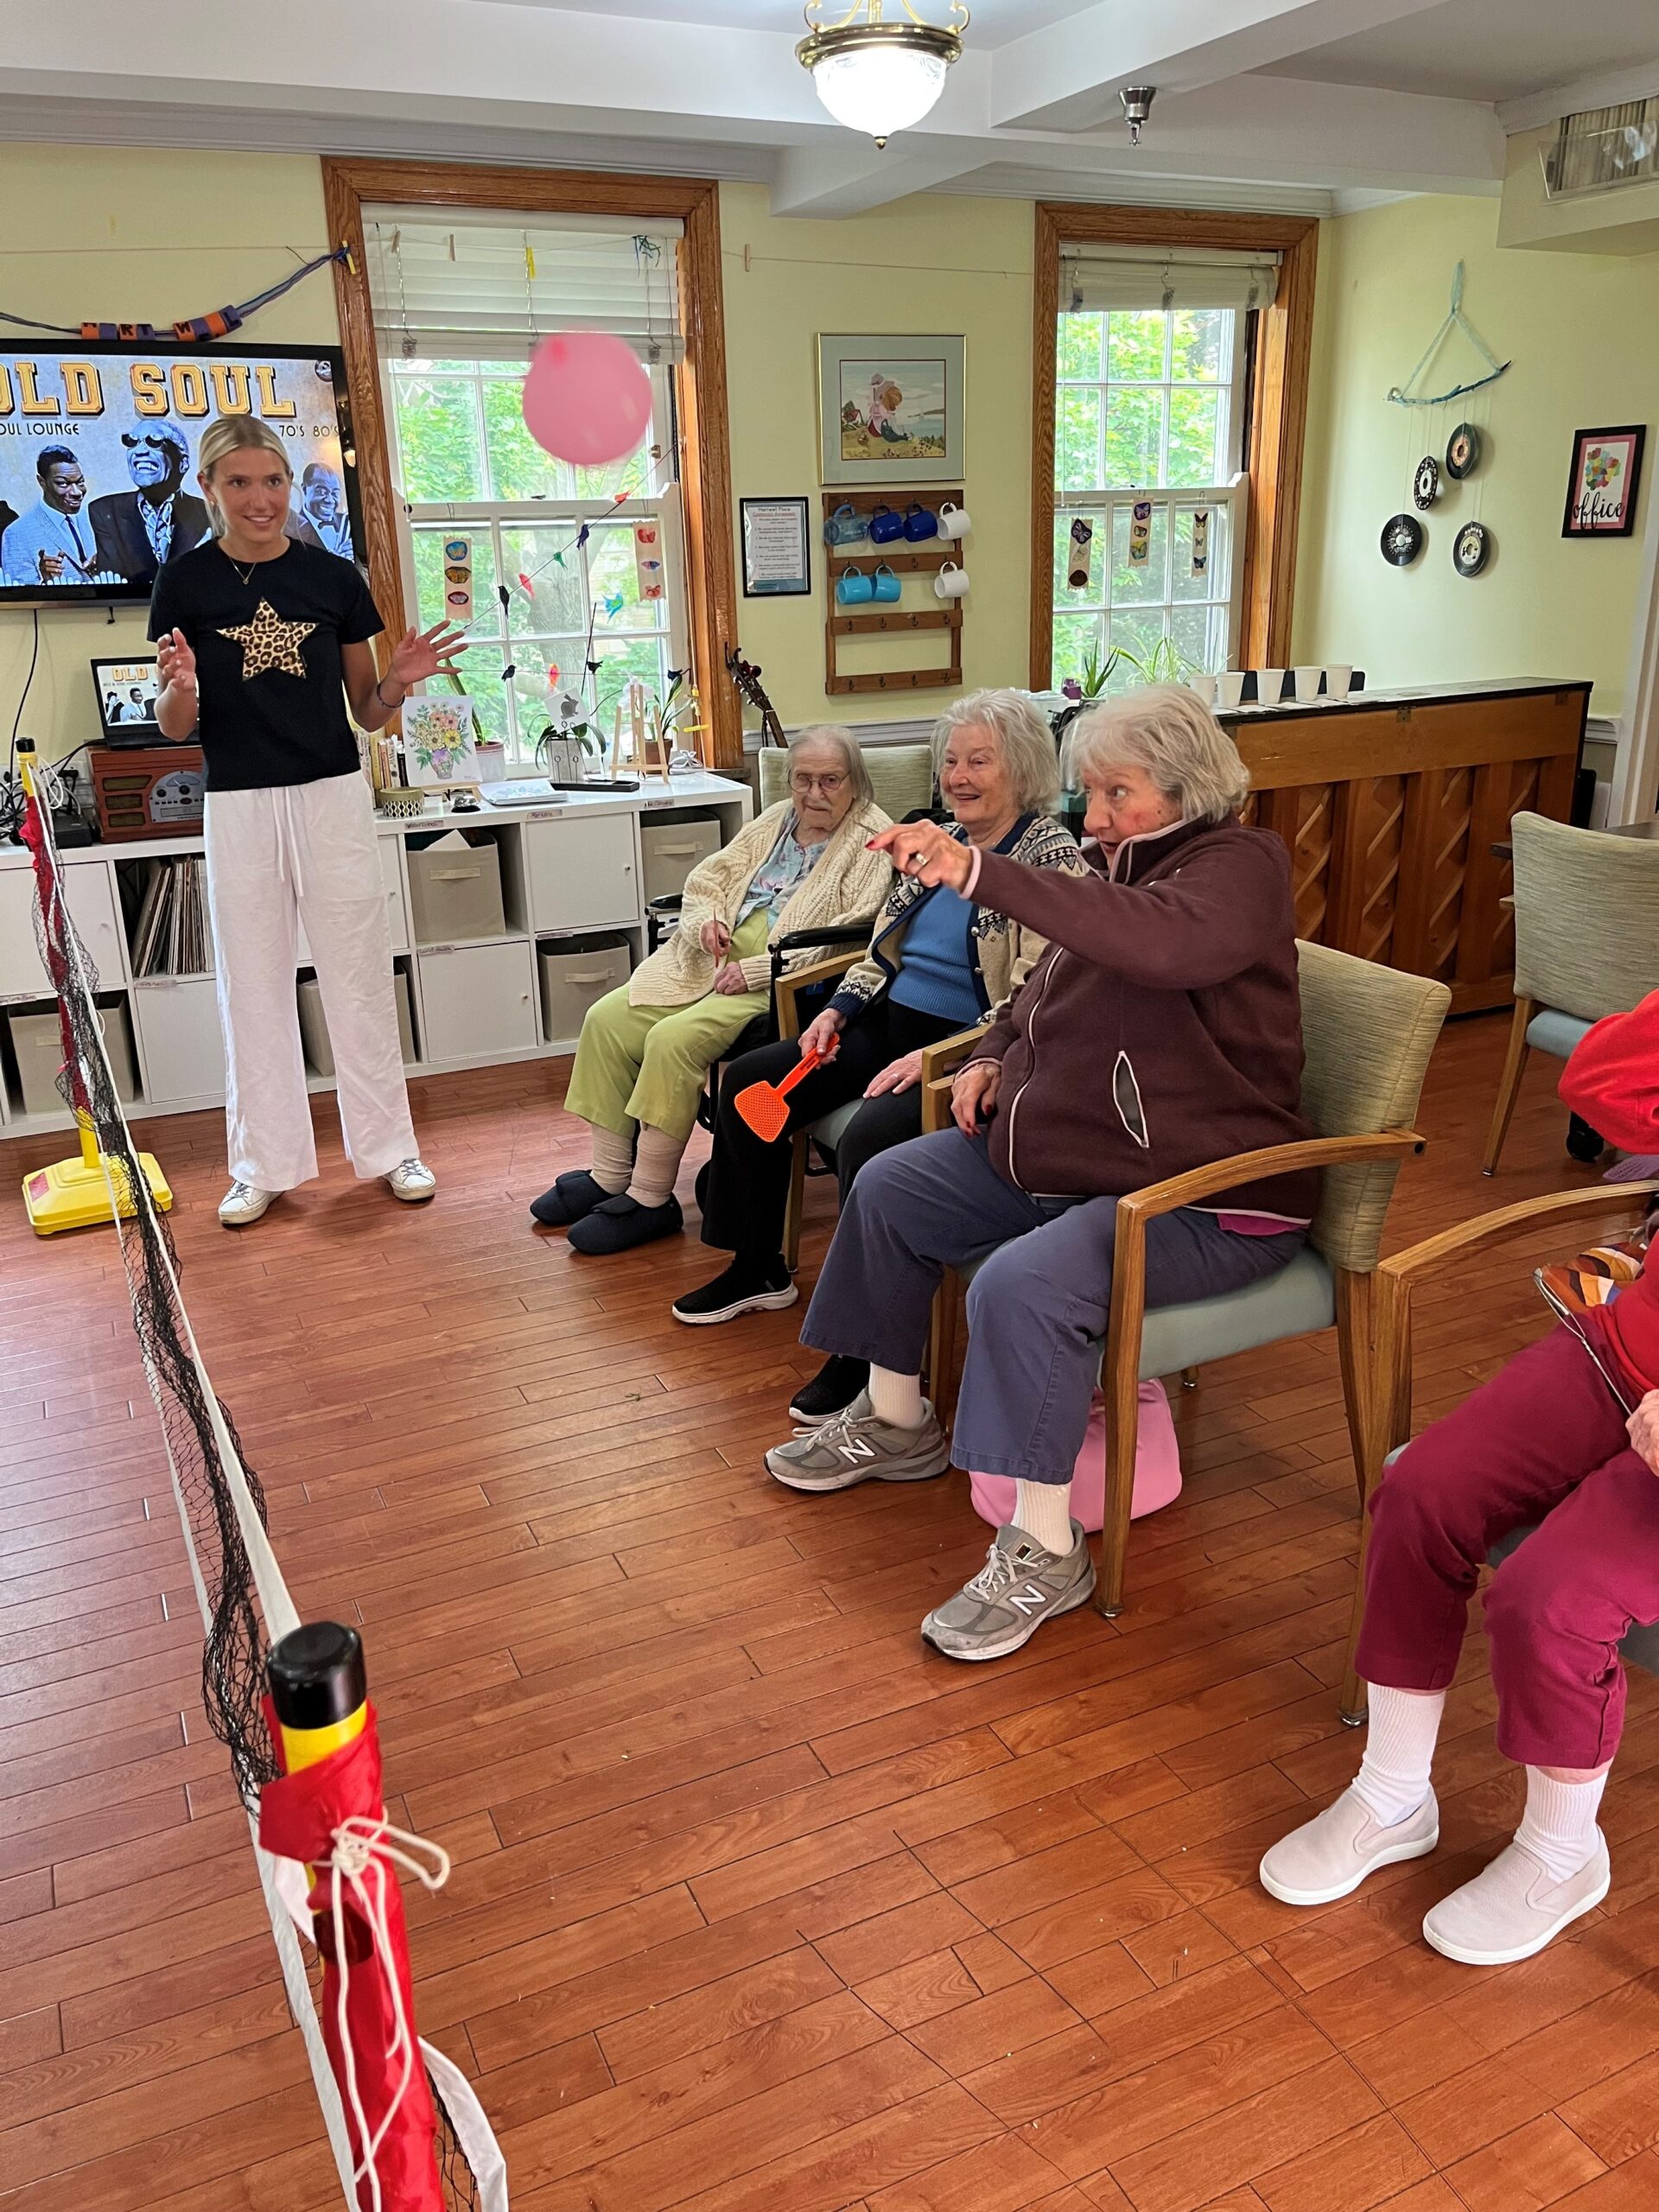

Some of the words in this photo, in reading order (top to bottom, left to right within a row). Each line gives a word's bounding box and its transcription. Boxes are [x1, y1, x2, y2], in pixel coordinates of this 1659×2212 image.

[130, 363, 296, 417] SOUL
[27, 423, 79, 435] LOUNGE
[279, 425, 305, 437] 70'S
[314, 425, 340, 437] 80'S
[1573, 492, 1624, 530] office
[112, 666, 148, 681] OLD
[837, 1437, 876, 1464] N
[1008, 1583, 1047, 1616] N
